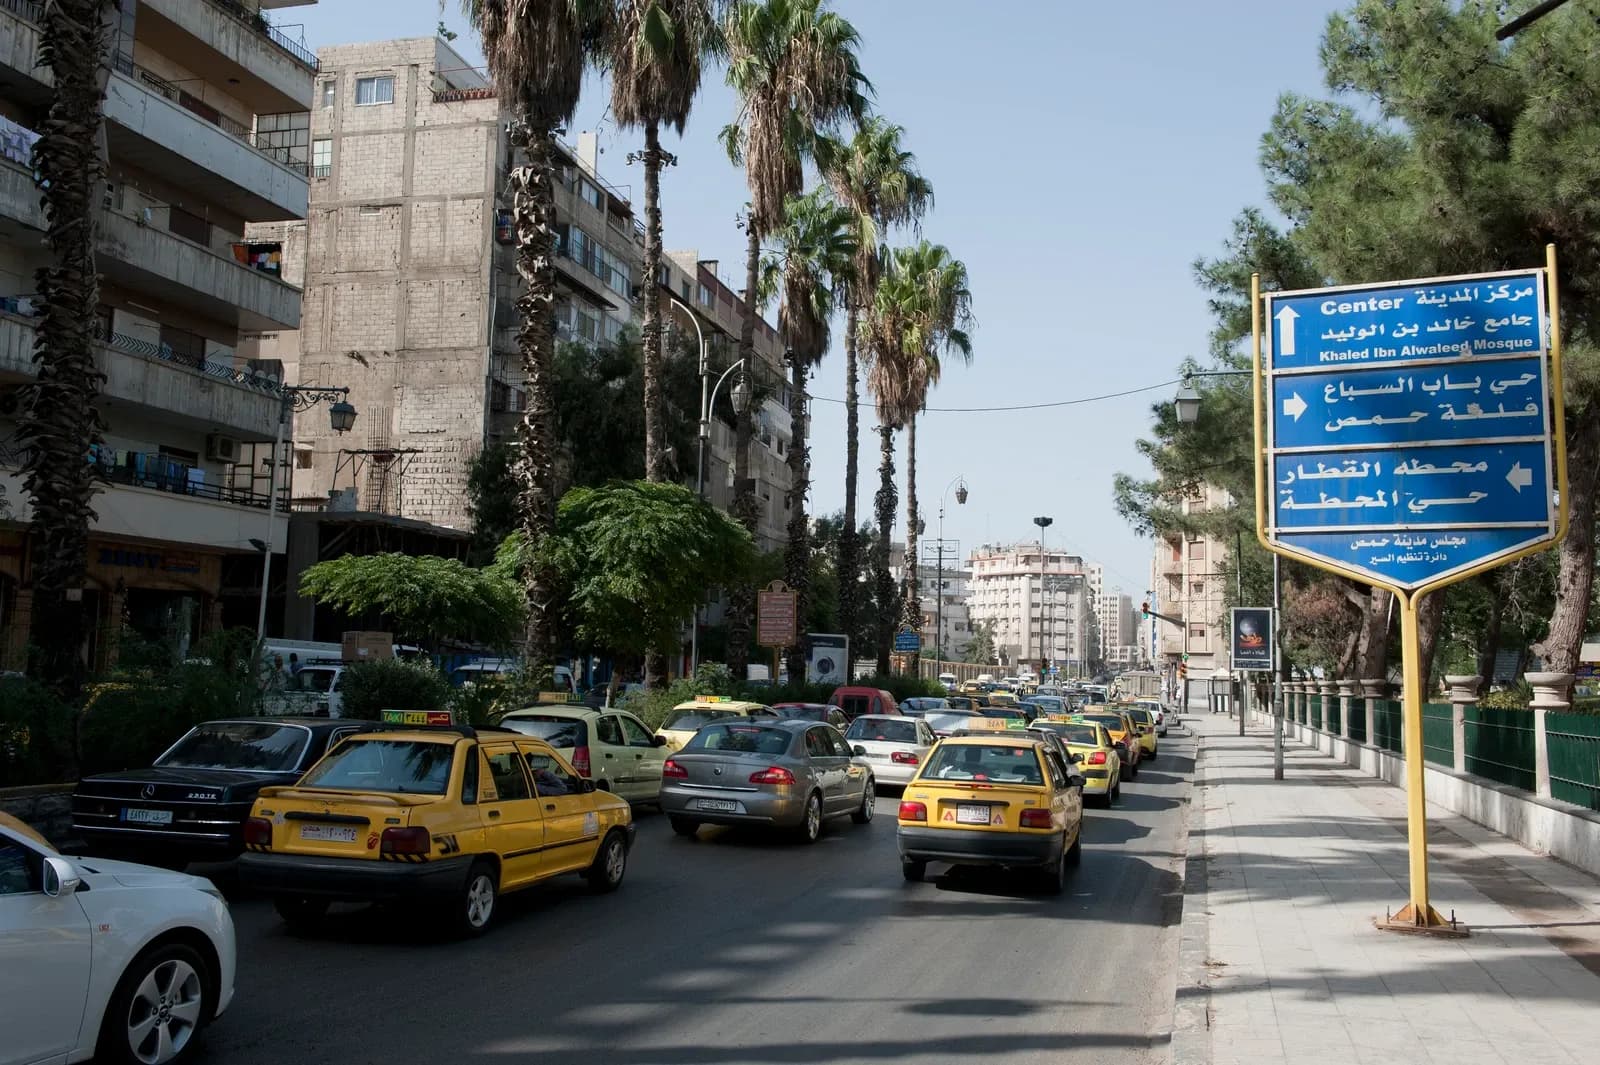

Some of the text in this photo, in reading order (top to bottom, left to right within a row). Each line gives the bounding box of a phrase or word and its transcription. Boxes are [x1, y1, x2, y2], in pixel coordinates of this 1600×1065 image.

[1320, 297, 1404, 315] Center
[1414, 284, 1534, 307] مركز المدينة
[1321, 313, 1533, 342] جامع خالد بن الوليد
[1319, 338, 1533, 362] Khaled Ibn Alwaleed Mosque
[1324, 372, 1537, 403] حي باب السباع
[1324, 397, 1539, 432] قلعة حمص
[1279, 460, 1381, 485] القطار
[1279, 488, 1488, 514] حي المحطة
[1350, 533, 1467, 550] مجلس مدينة حمص
[1369, 552, 1447, 565] دائرة تنظيم السير
